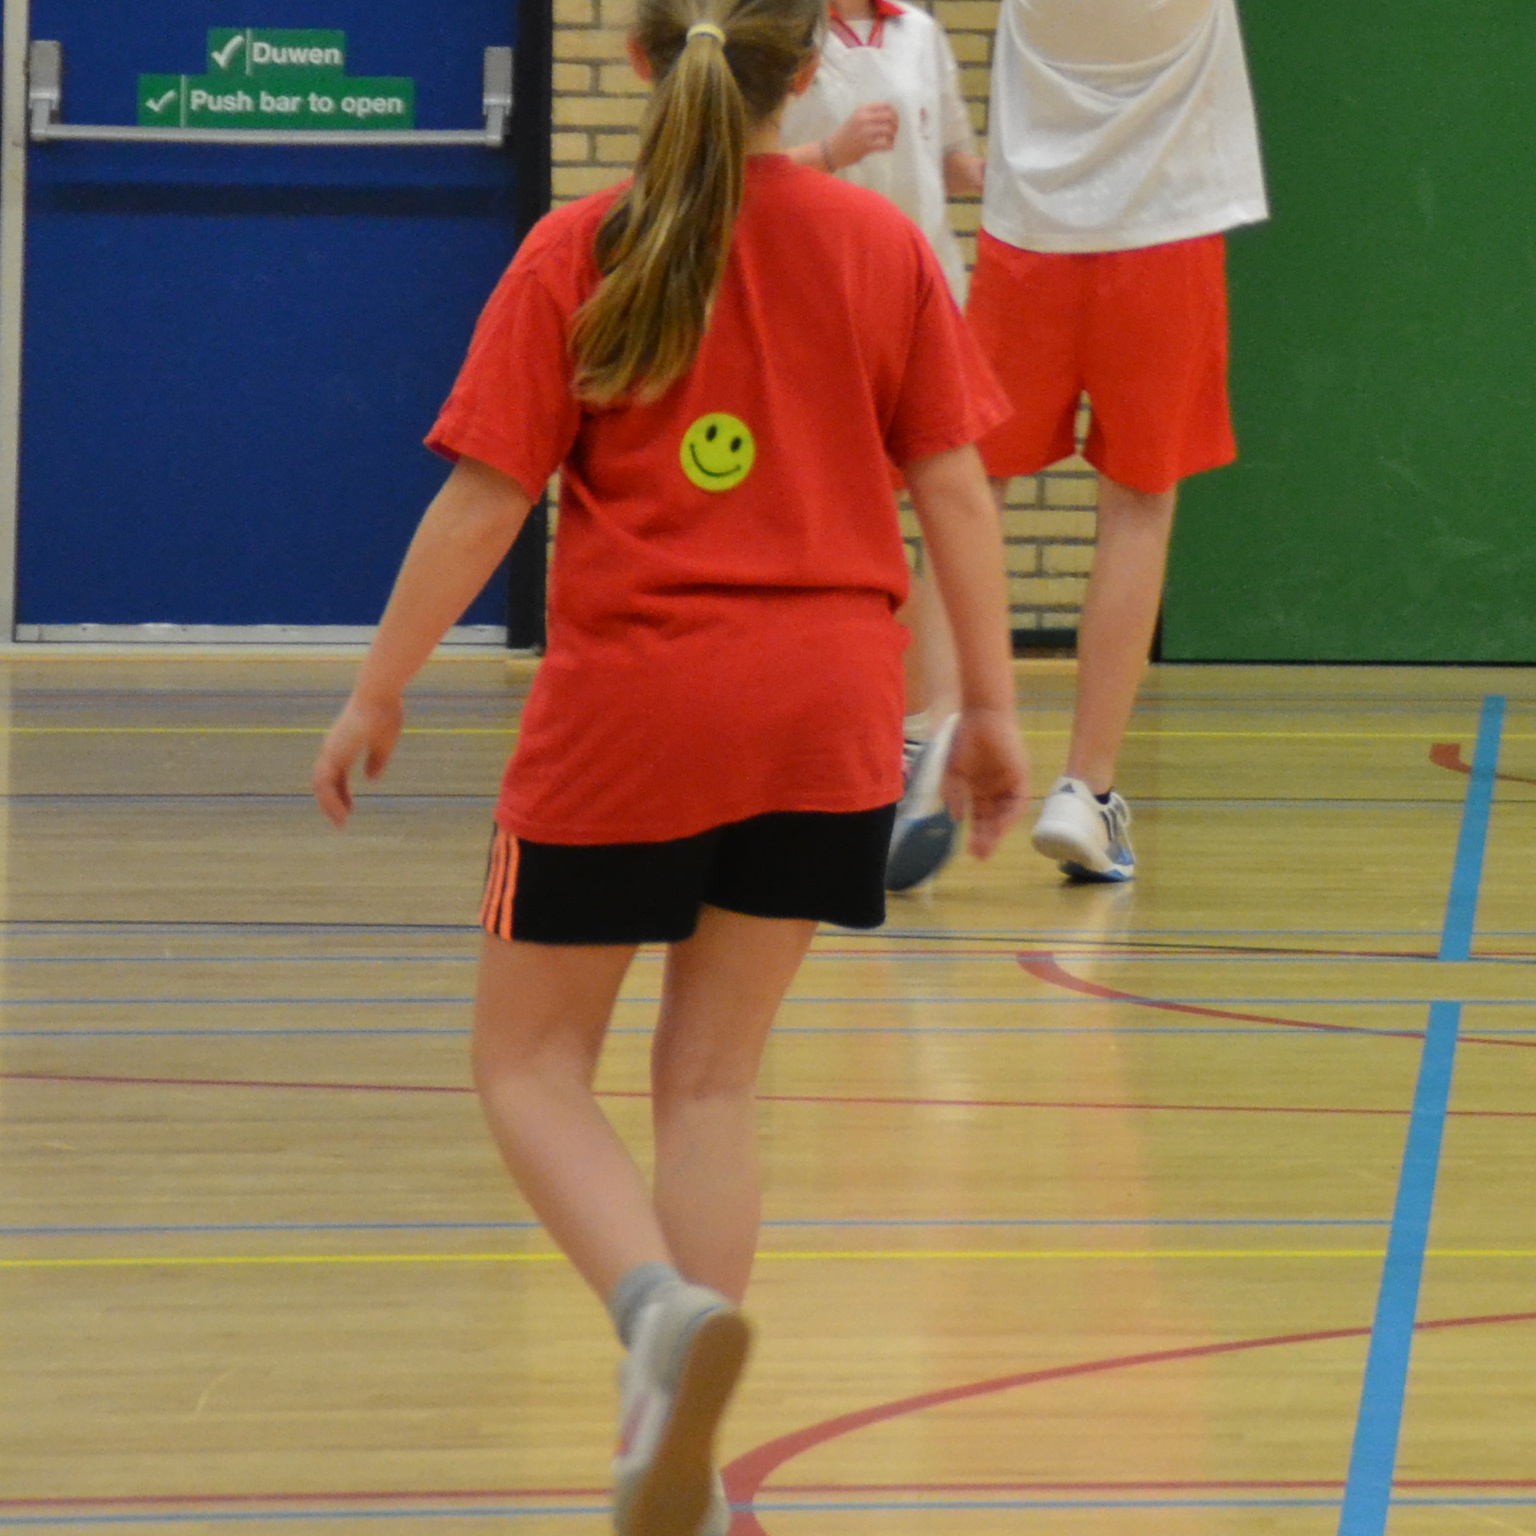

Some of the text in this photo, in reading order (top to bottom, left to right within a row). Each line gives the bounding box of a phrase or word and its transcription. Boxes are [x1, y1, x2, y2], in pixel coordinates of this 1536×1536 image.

[252, 41, 343, 65] Duwen
[190, 89, 404, 119] Push bar to open
